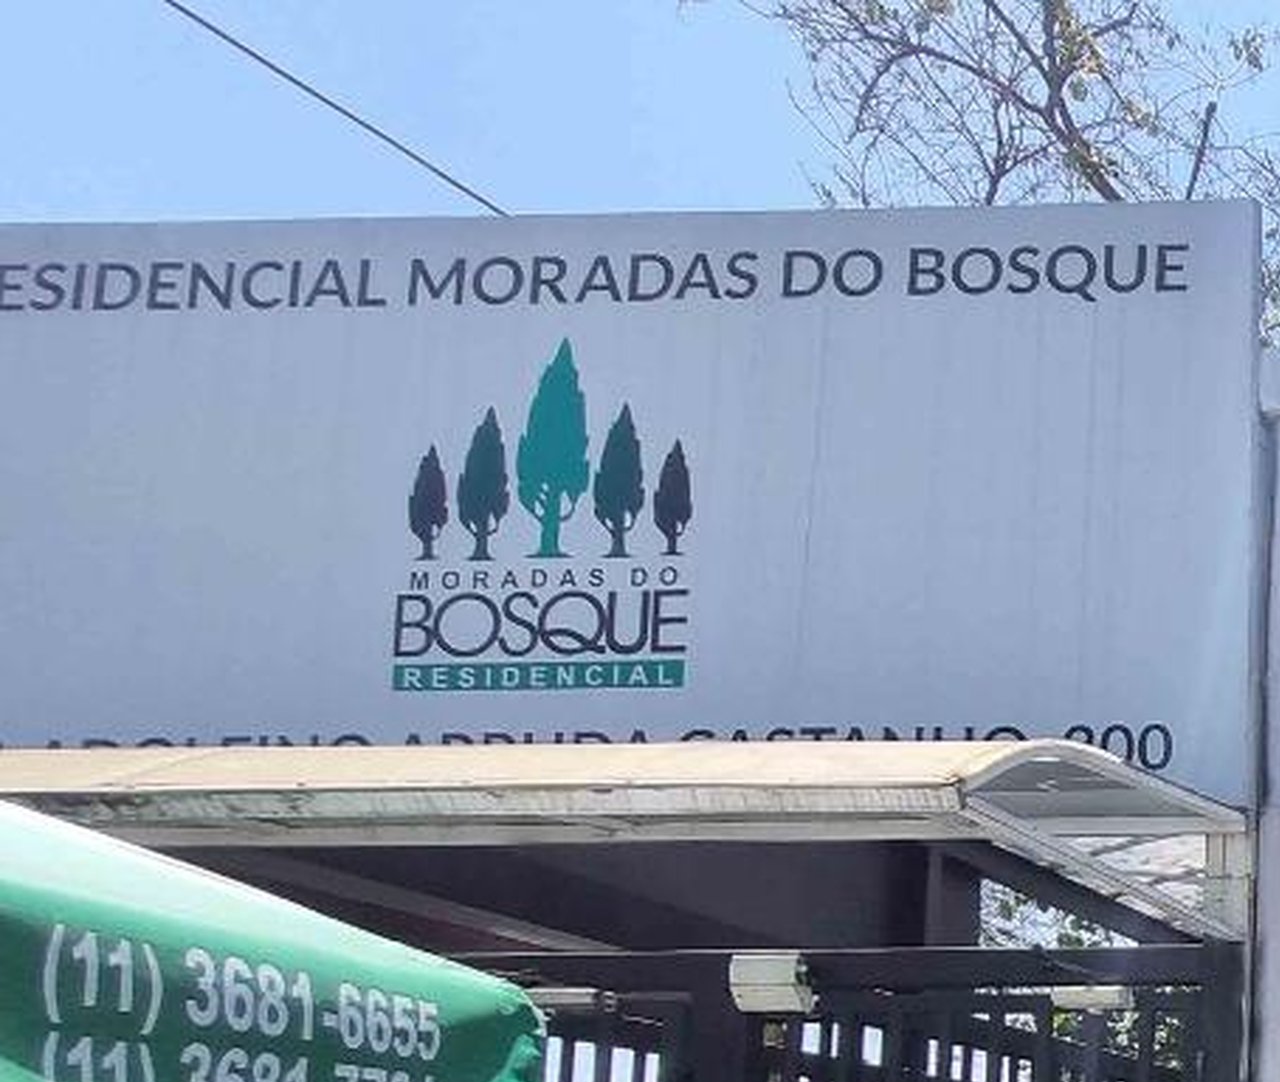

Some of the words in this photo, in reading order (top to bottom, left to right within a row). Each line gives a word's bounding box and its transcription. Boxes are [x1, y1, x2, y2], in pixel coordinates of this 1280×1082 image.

[407, 252, 760, 306] MORADAS
[780, 249, 884, 298] DO
[906, 244, 1190, 302] BOSQUE
[409, 568, 605, 590] MORADAS
[630, 566, 679, 587] DO
[394, 589, 690, 657] BOSQUE
[402, 665, 674, 689] RESIDENCIAL
[43, 923, 165, 1036] (11)
[184, 947, 441, 1061] 3681-6655
